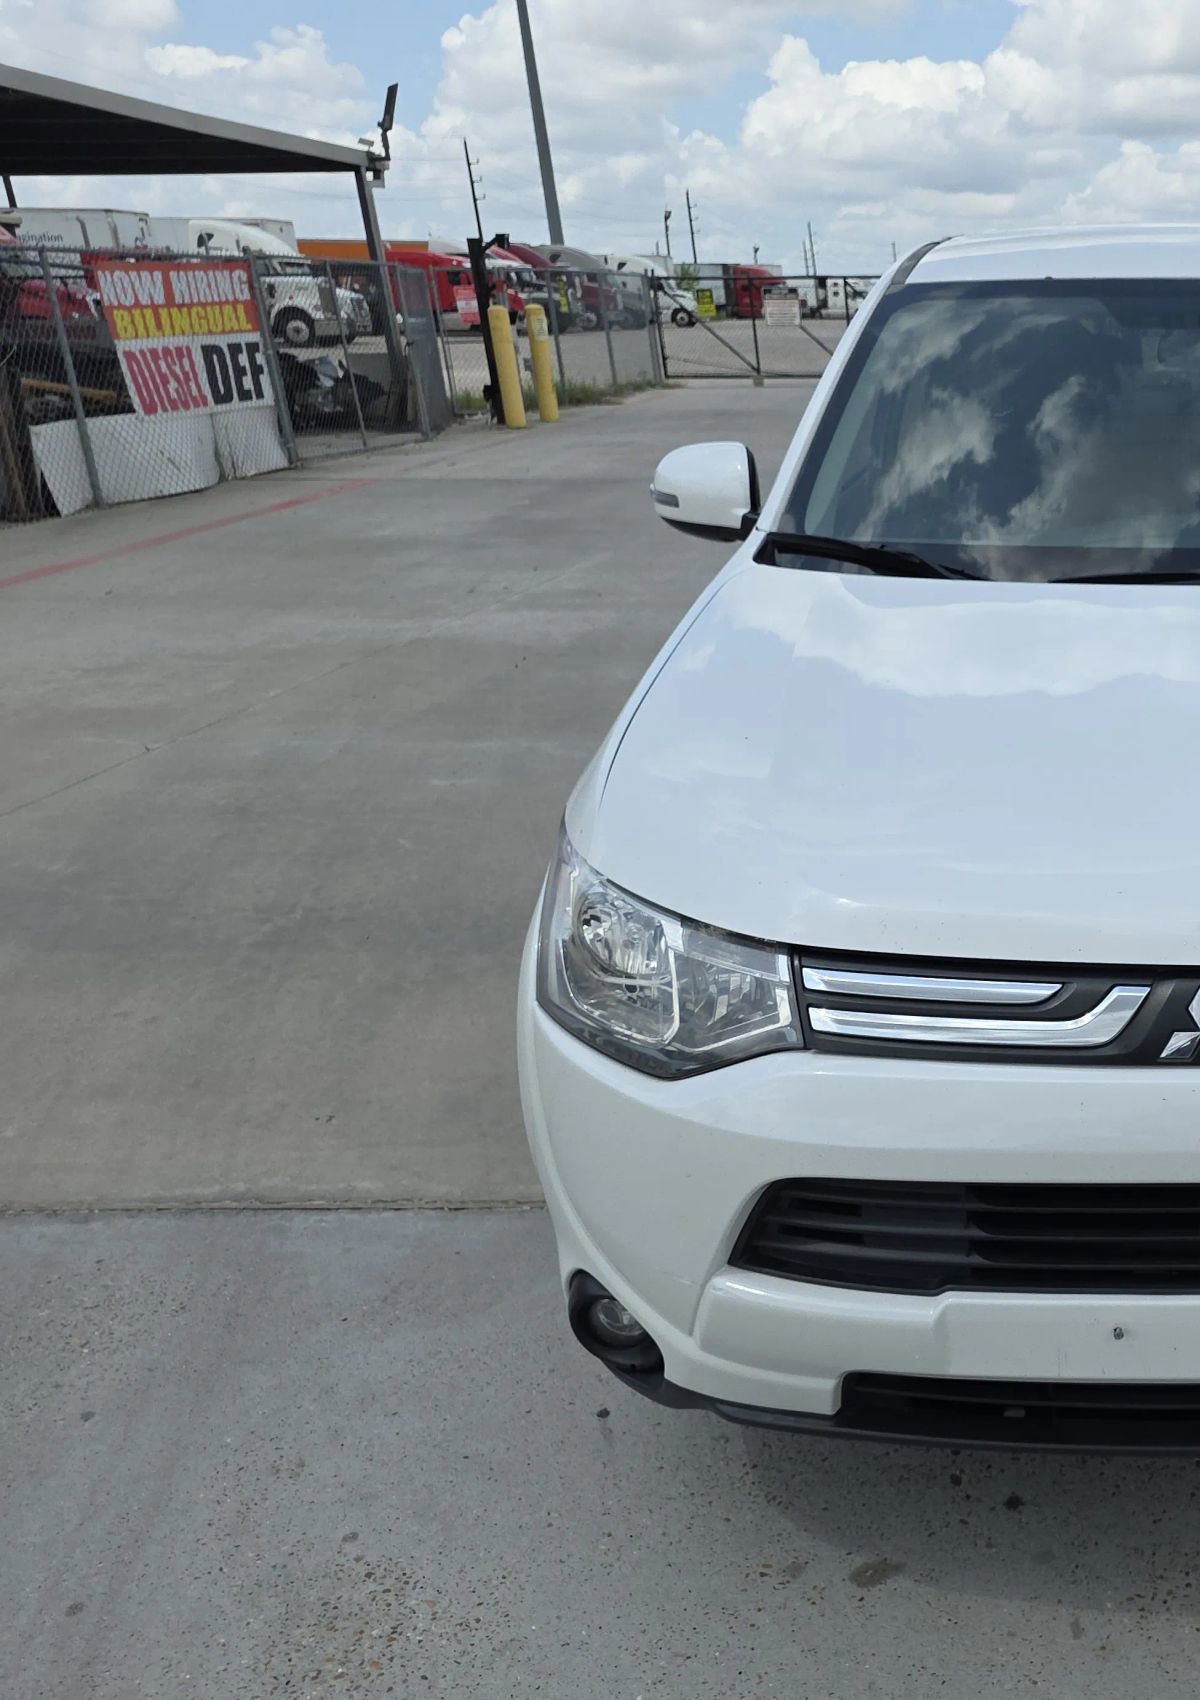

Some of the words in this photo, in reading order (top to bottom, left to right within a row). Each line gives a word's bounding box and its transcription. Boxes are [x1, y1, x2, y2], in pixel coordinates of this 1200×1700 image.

[98, 270, 166, 307] NOW
[169, 269, 250, 305] HIRING
[112, 303, 252, 341] BILINGUAL
[123, 346, 208, 416] DIESEL
[201, 342, 264, 404] DEF
